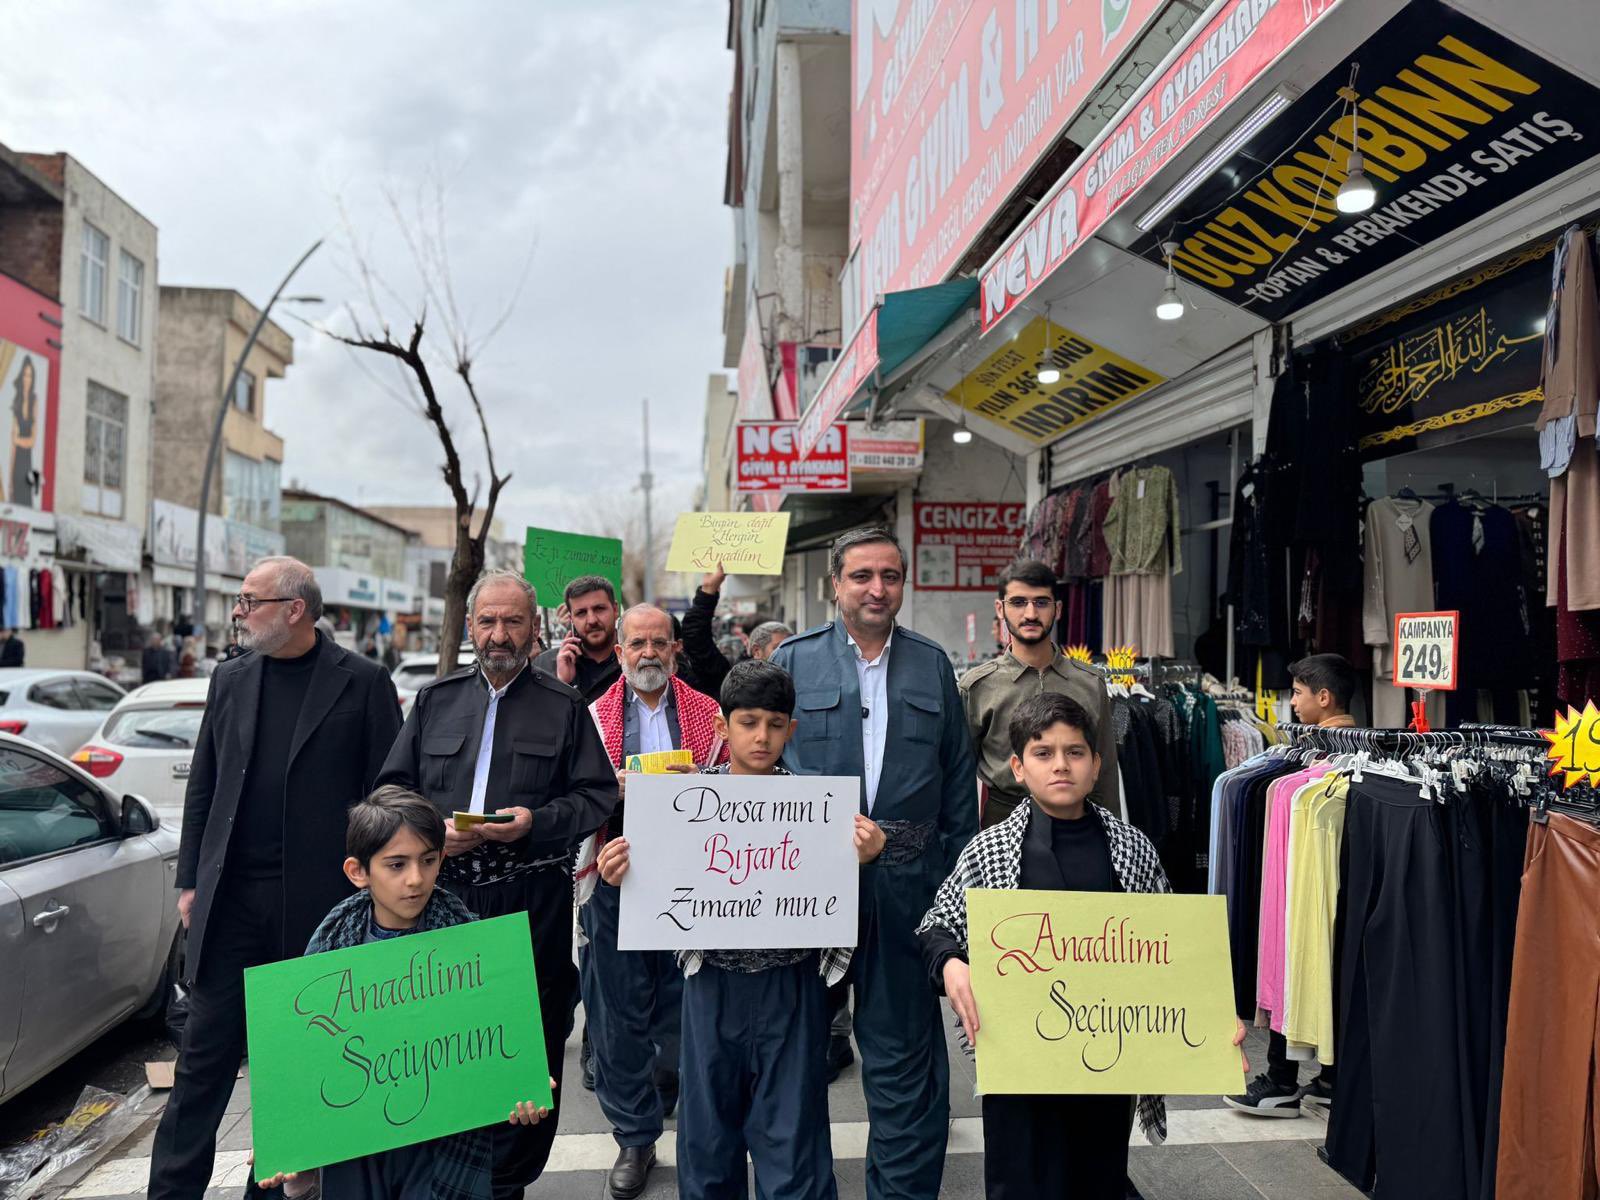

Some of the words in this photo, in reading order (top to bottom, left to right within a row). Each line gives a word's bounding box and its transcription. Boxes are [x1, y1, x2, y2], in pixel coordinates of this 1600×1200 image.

[904, 62, 969, 247] GİYİM
[979, 5, 1004, 130] &
[1003, 74, 1052, 175] İNDİRİM
[1055, 29, 1084, 104] VAR
[984, 188, 1078, 325] NEVA
[1084, 126, 1135, 198] GİYİM
[1139, 105, 1156, 142] &
[1160, 0, 1279, 123] AYAKKAB
[1470, 111, 1584, 174] SATIŞ
[1161, 206, 1300, 288] UCUZ
[1331, 163, 1487, 254] PERAKENDE
[1245, 256, 1329, 302] TOPTAN
[1315, 247, 1350, 264] &
[999, 361, 1151, 438] İNDİRİM
[1006, 370, 1039, 395] 365
[1400, 620, 1454, 639] KAMPANYA
[673, 786, 764, 823] Dersa
[991, 912, 1174, 977] Anadilimi
[294, 948, 485, 1036] Anadilimi
[1036, 979, 1207, 1072] Seçiyorum
[320, 1023, 521, 1126] Seçiyorum
